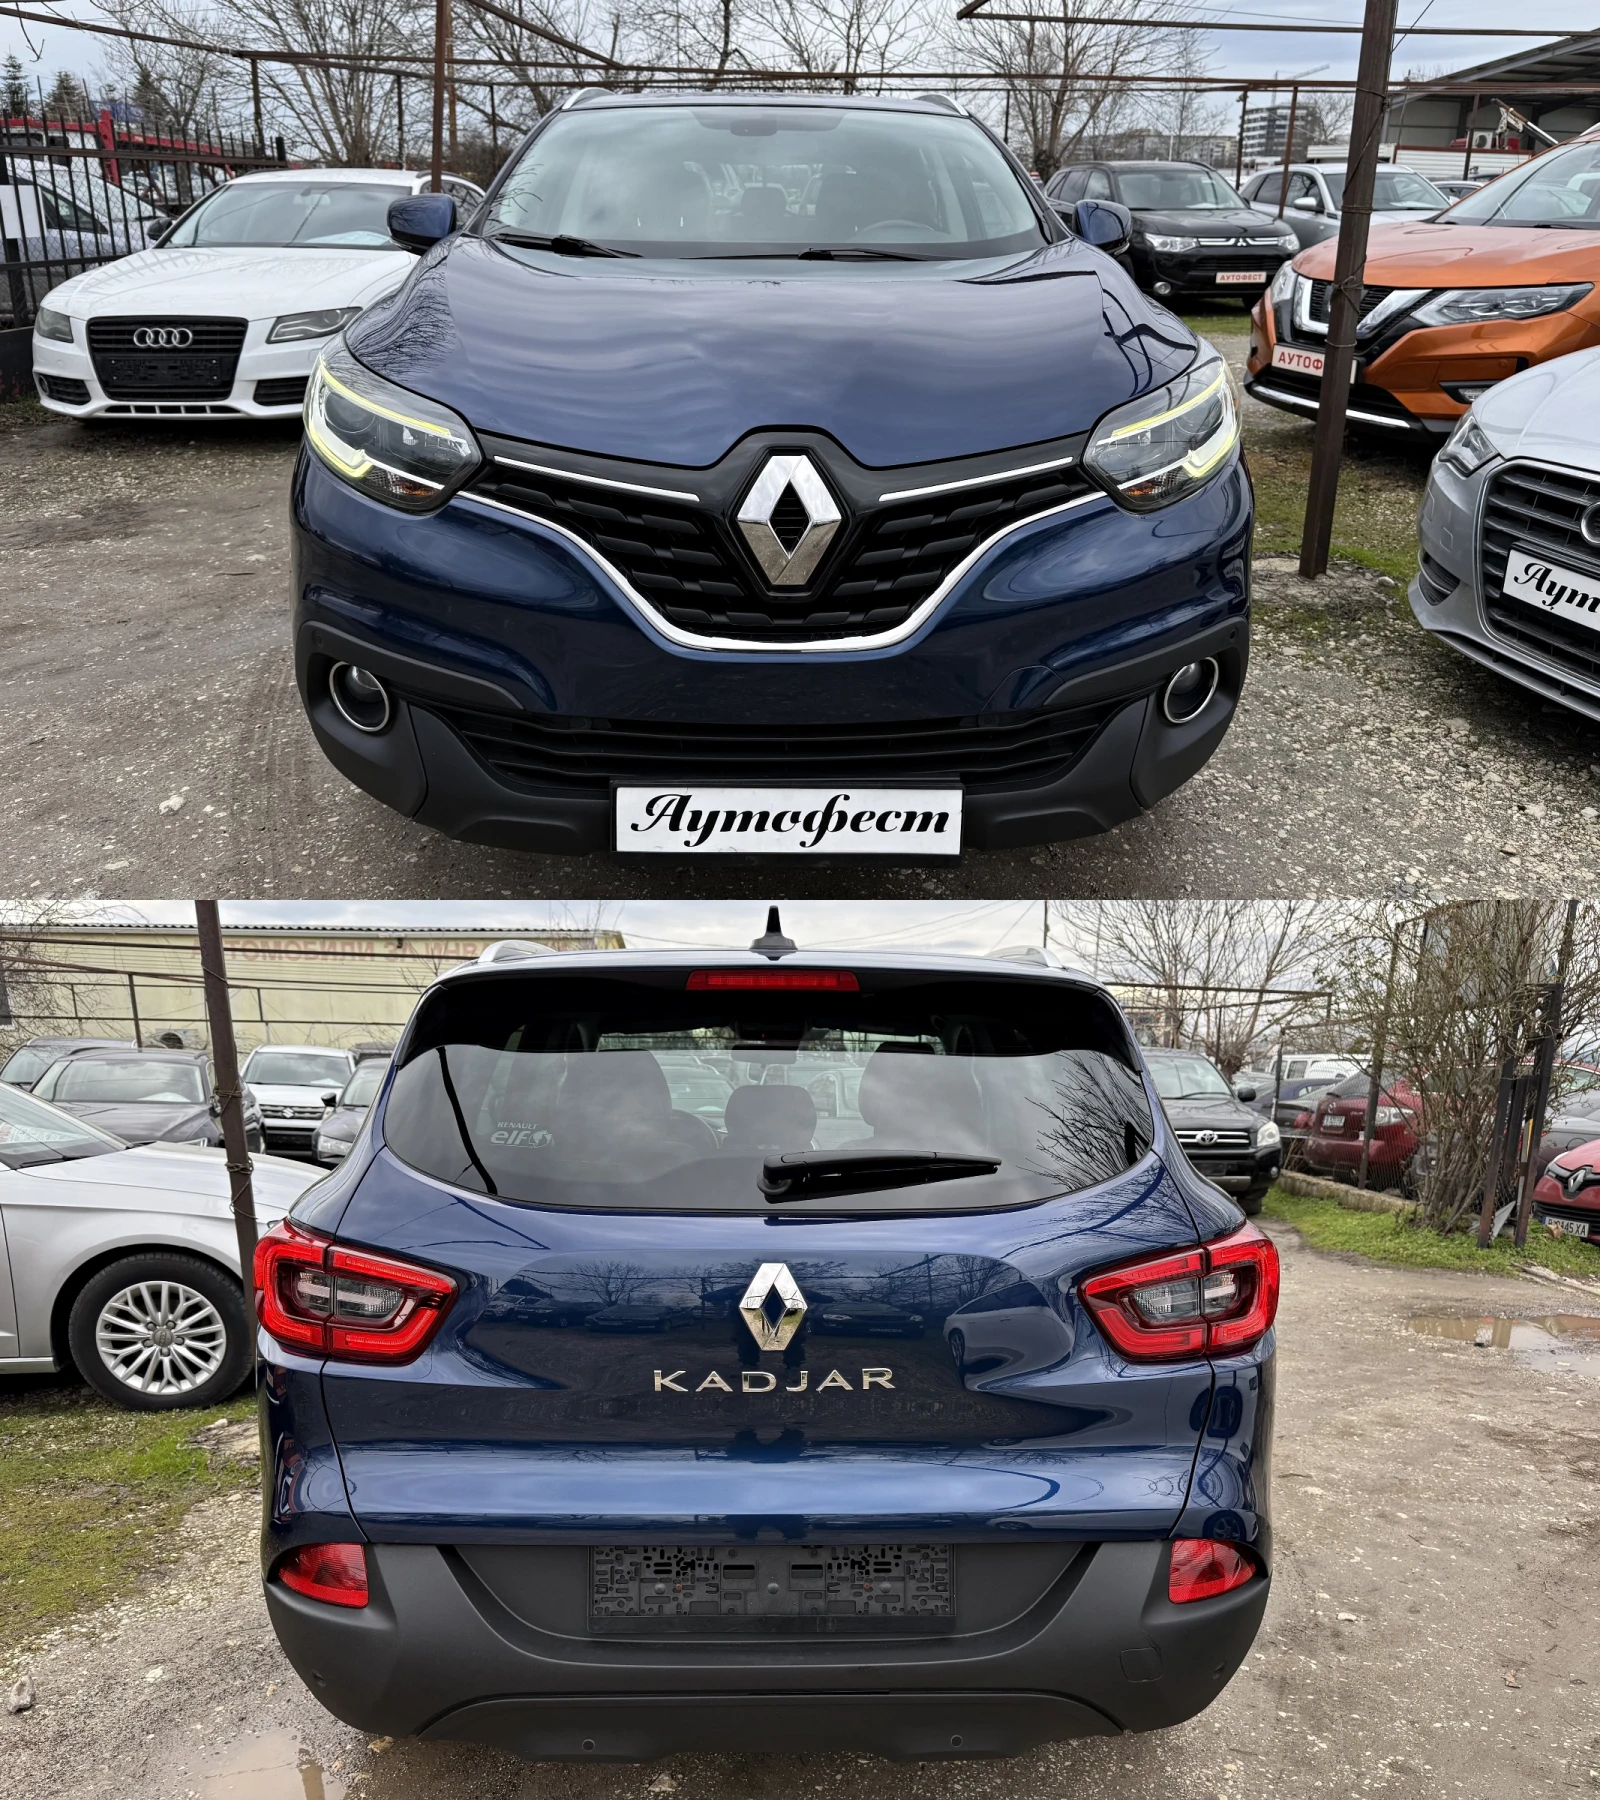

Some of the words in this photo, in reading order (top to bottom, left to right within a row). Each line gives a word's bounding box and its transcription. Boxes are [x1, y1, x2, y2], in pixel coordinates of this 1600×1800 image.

[1219, 273, 1263, 281] АУТОФЕСТ
[630, 793, 950, 848] Аутофест
[190, 939, 375, 962] АТОМОБИЛИ
[497, 1121, 539, 1130] RENAULT
[490, 1130, 530, 1145] elf
[653, 1367, 896, 1393] KADJAR
